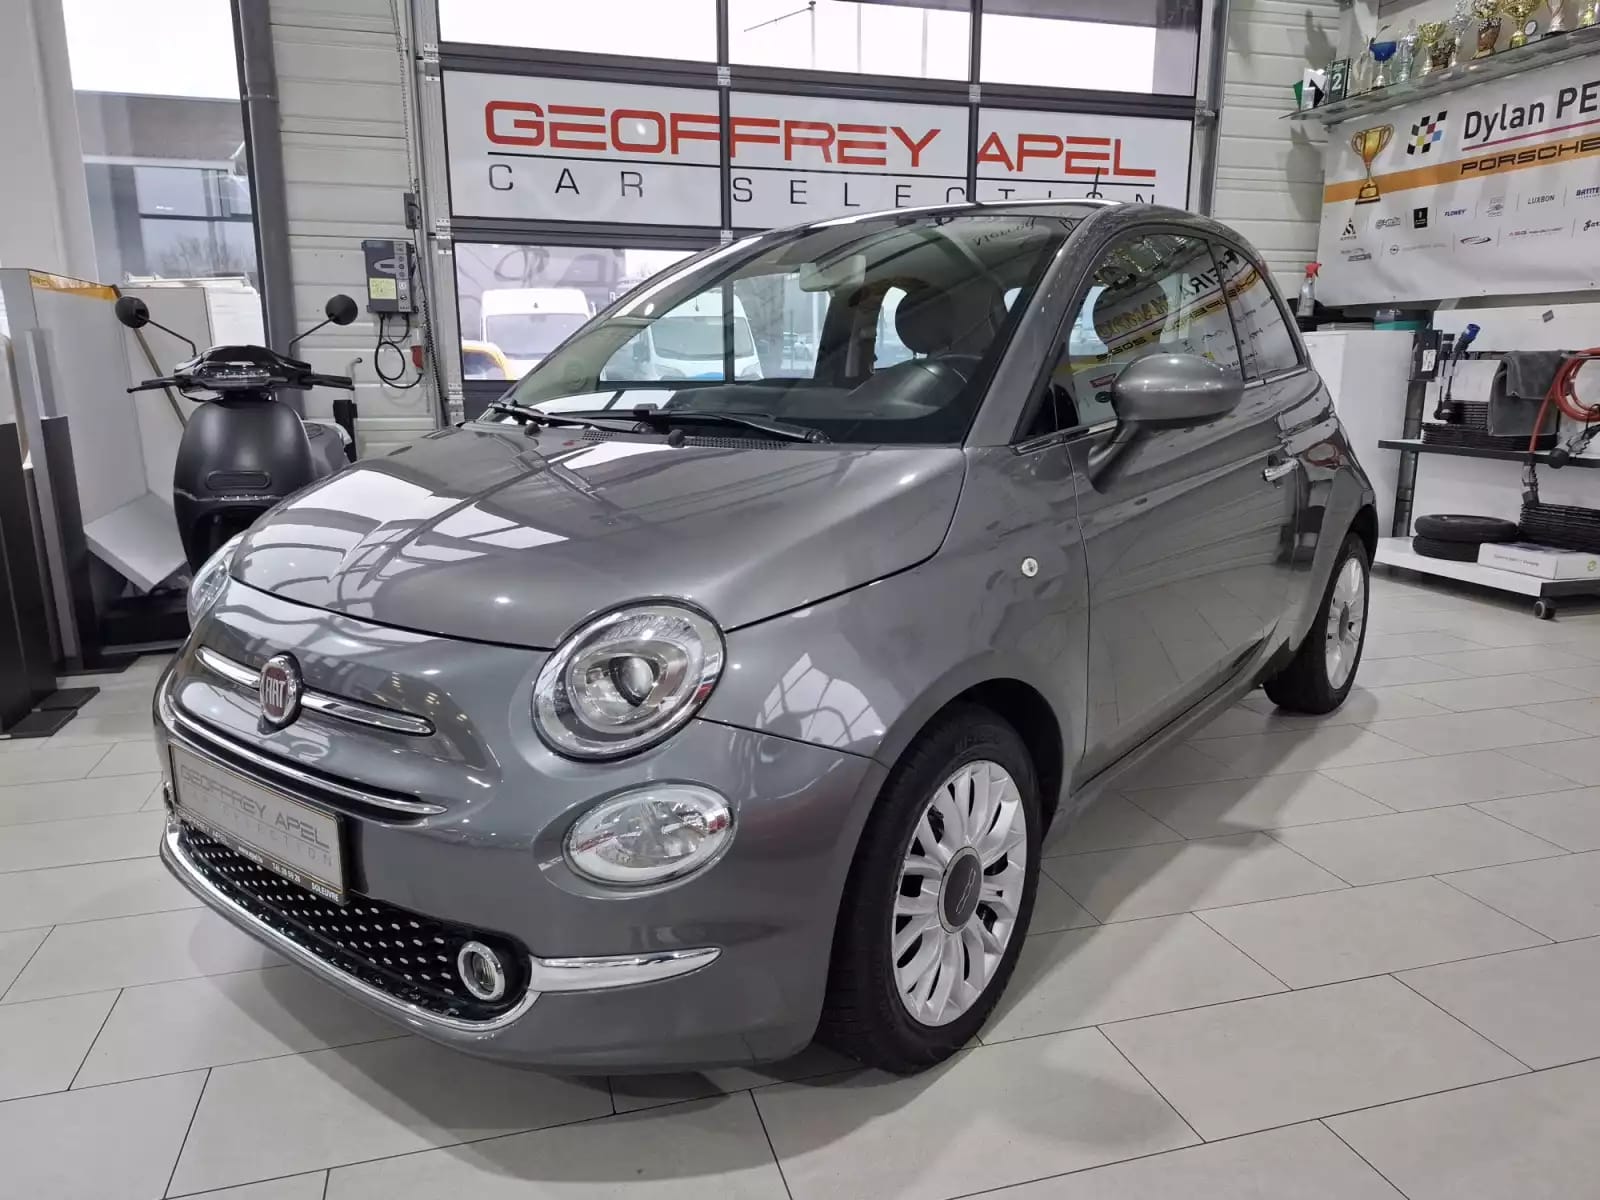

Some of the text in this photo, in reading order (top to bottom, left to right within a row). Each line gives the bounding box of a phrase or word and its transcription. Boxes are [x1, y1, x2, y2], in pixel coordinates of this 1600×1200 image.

[1331, 72, 1342, 91] 2
[485, 100, 1156, 177] GEOFFREY APEL
[1463, 102, 1545, 142] Dylan
[1460, 137, 1600, 175] PORSCHE
[488, 164, 644, 197] CAR
[265, 675, 286, 708] FIAT
[275, 811, 331, 850] APEL
